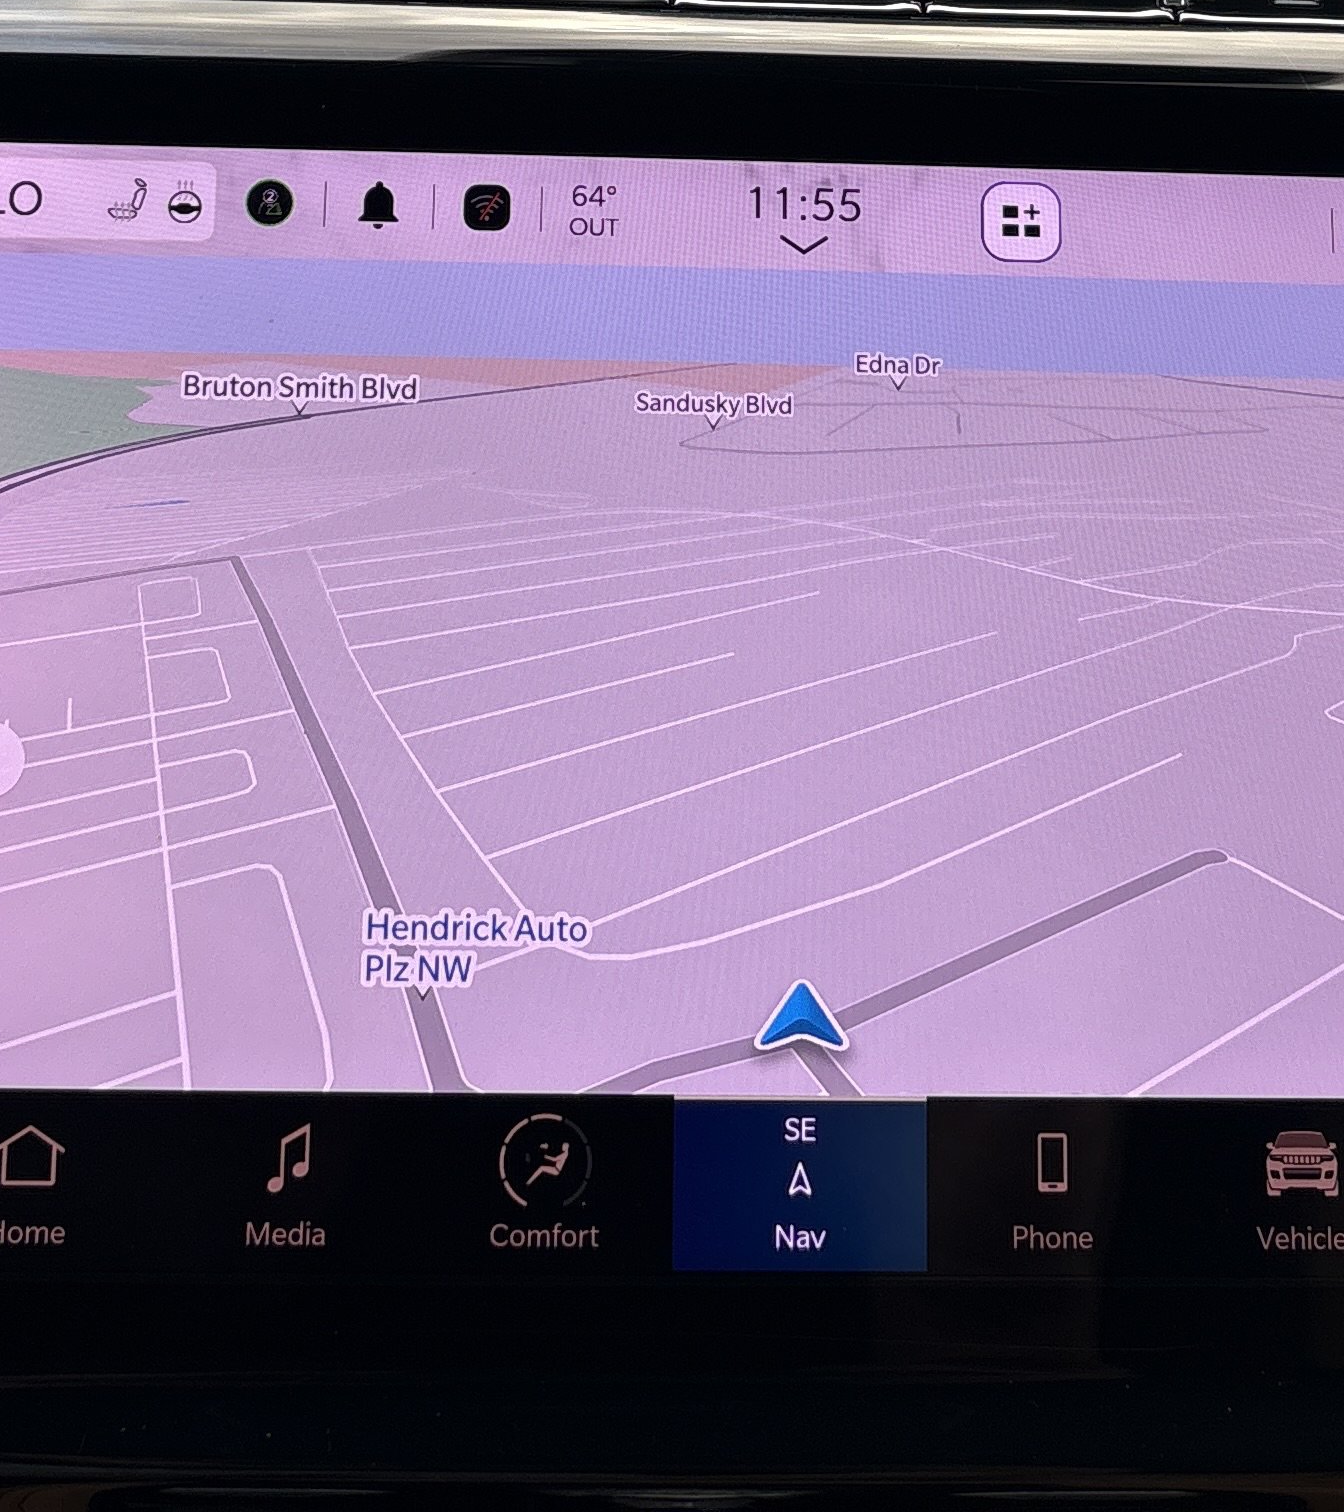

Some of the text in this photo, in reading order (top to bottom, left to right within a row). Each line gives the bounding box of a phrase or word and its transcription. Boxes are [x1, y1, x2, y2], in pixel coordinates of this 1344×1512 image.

[572, 185, 617, 208] 64°
[749, 186, 862, 222] 11:55
[569, 217, 619, 237] OUT
[856, 354, 941, 375] Edna Dr
[184, 375, 417, 400] Bruton Smith Blvd
[636, 392, 792, 417] Sandusky Blvd
[367, 912, 588, 942] Hendrick Auto
[365, 954, 473, 982] Plz NW
[784, 1117, 817, 1142] SE
[245, 1220, 327, 1247] Media
[489, 1222, 600, 1249] Comfort
[774, 1224, 827, 1250] Nav
[1012, 1225, 1094, 1249] Phone
